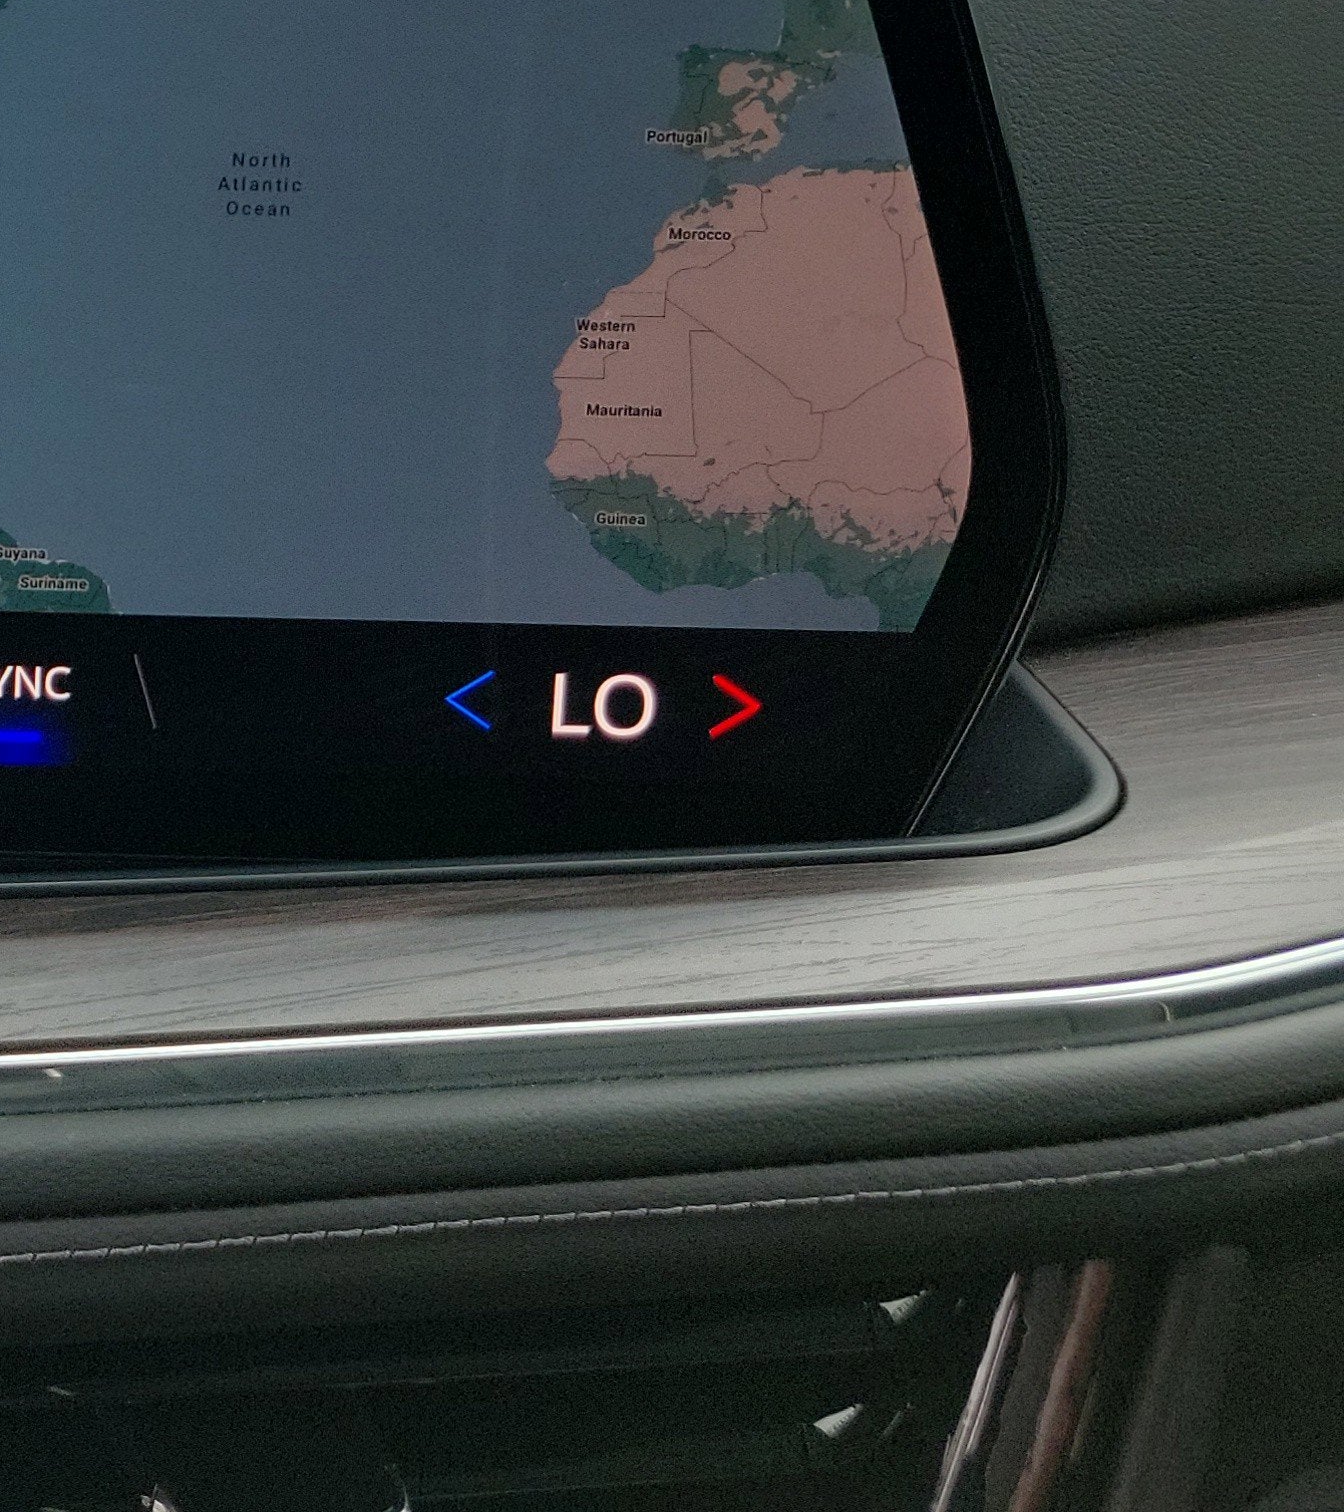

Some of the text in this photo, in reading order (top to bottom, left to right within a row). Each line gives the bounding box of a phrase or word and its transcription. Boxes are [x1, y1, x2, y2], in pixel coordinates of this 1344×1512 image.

[647, 129, 708, 146] Portugal
[233, 152, 291, 168] North
[219, 177, 303, 192] Atlantic
[226, 202, 291, 217] Ocean
[669, 227, 731, 241] Morocco
[576, 318, 636, 334] Western
[580, 337, 630, 351] Sahara
[586, 403, 662, 418] Mauritania
[596, 511, 646, 527] Guinea
[19, 575, 87, 591] Suriname
[552, 672, 658, 741] LO
